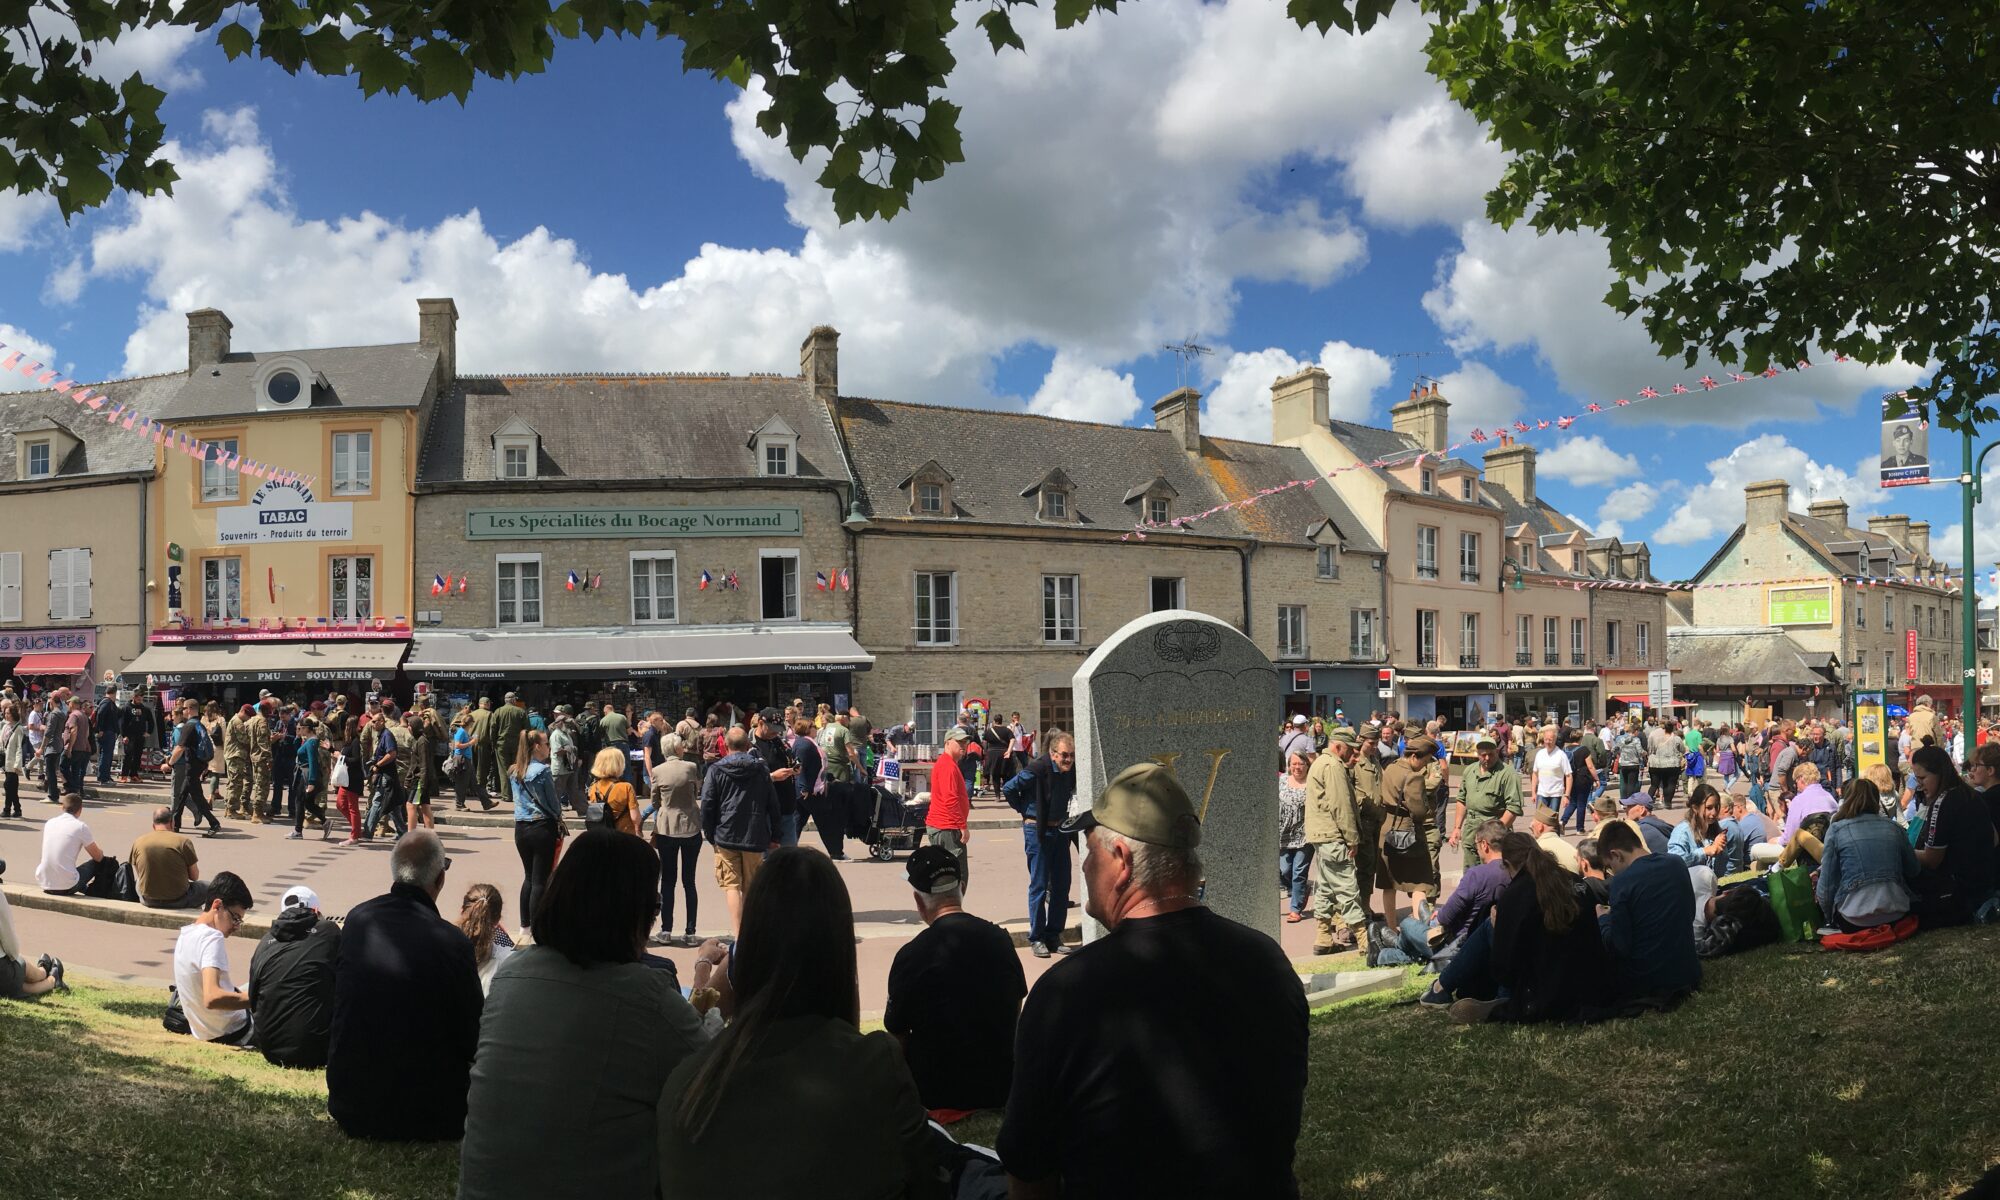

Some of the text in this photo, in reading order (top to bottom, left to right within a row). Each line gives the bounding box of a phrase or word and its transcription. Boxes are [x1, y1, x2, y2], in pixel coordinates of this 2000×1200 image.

[252, 489, 266, 506] LE
[261, 511, 305, 523] TABAC
[489, 512, 782, 532] Les Spécialités du Bocage Normand
[220, 530, 258, 541] Souvenirs
[270, 529, 303, 539] Produits
[306, 528, 317, 538] du
[321, 527, 348, 537] terroir
[628, 668, 668, 676] Souvenirs
[784, 663, 857, 672] Produits Régionaux
[145, 674, 182, 683] ABAC
[206, 673, 234, 681] LOTO
[257, 672, 281, 681] PMU
[306, 671, 373, 680] SOUVENIRS
[460, 671, 505, 680] Régionaux
[1488, 682, 1519, 690] MILITARY
